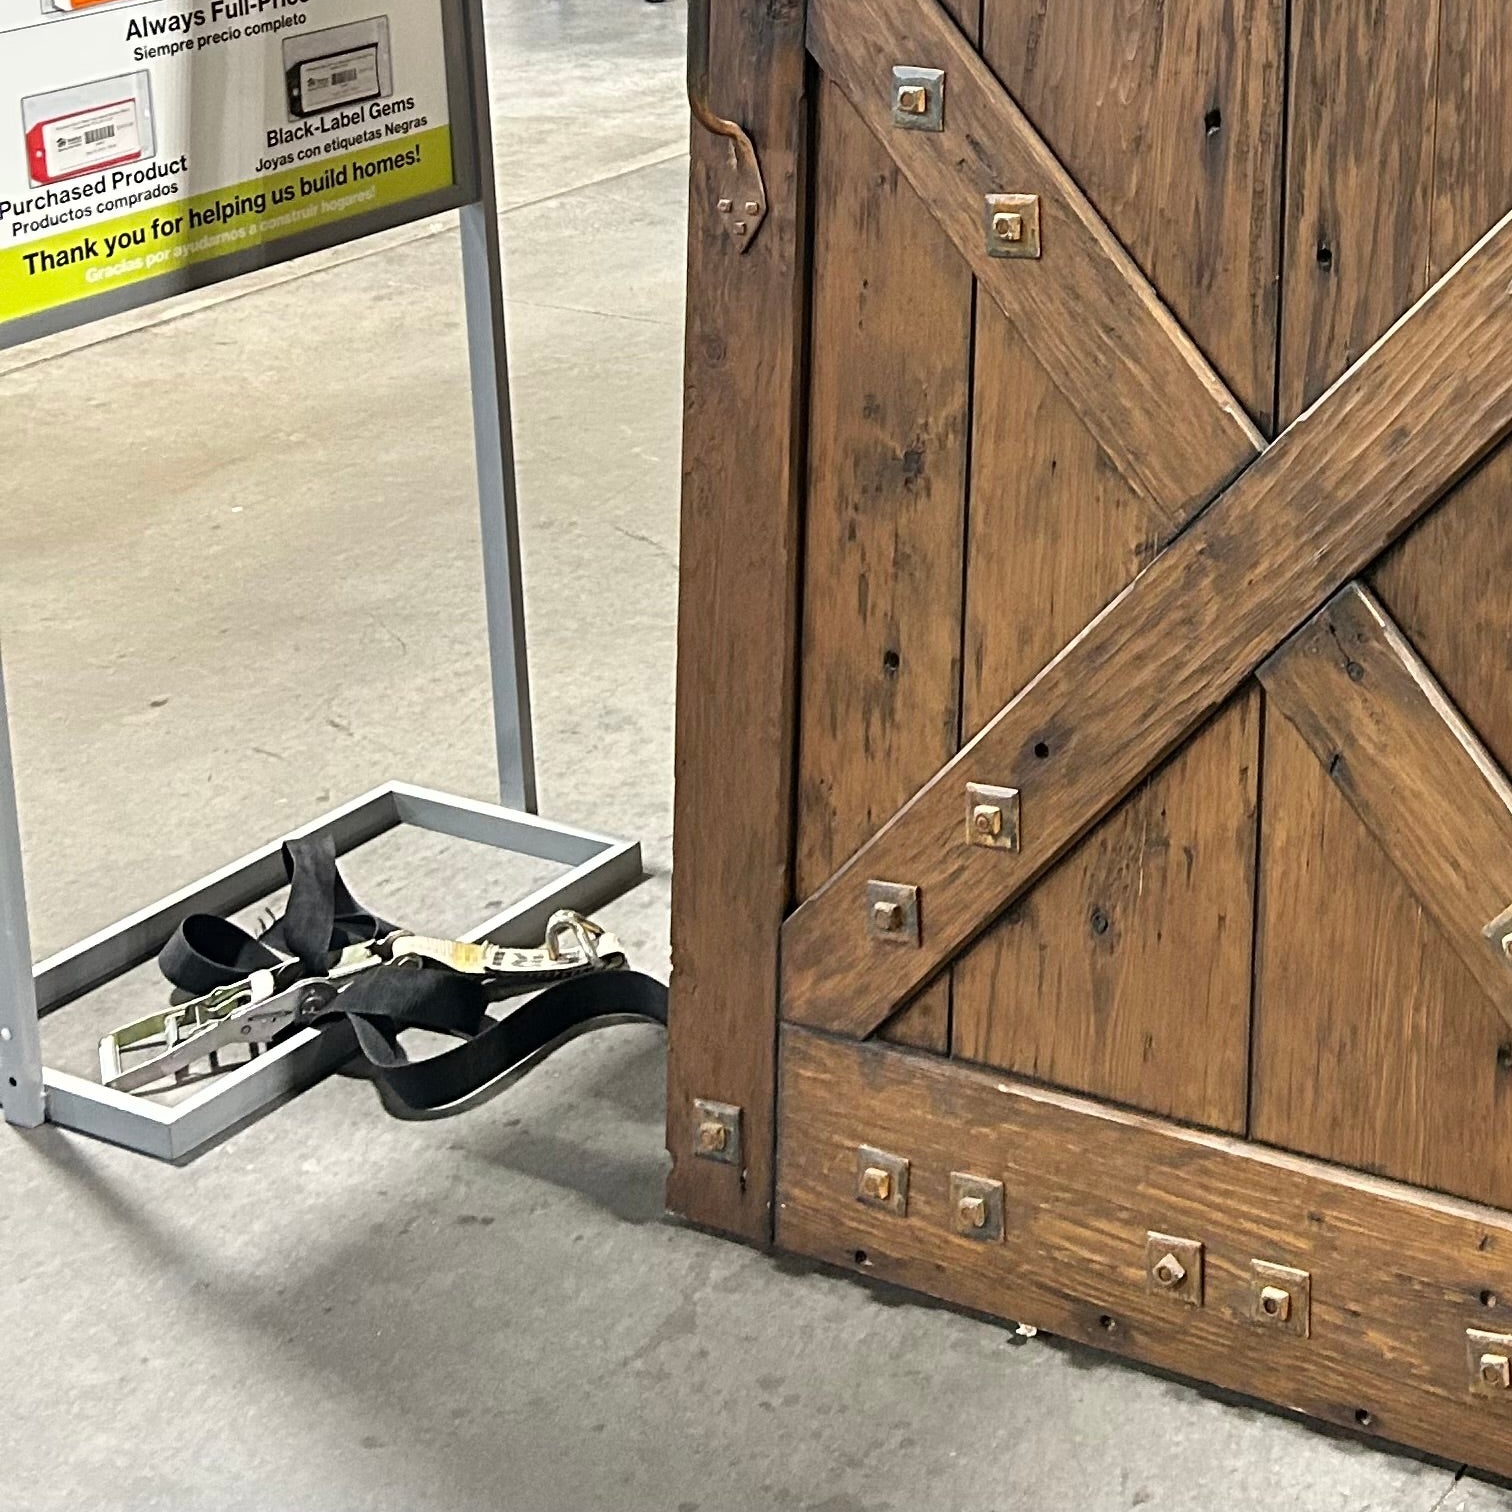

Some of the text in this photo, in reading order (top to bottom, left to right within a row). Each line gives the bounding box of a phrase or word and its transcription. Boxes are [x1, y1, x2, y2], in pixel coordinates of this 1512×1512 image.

[126, 9, 206, 41] Always
[133, 12, 307, 62] Siempre precio completo
[255, 115, 428, 173] Joyas con etiquetas Negras
[266, 96, 415, 148] Black-Label Gems
[0, 154, 189, 220] Purchased Product
[12, 181, 179, 237] Productos comprados
[22, 144, 421, 276] Thank you for helping us build homes!
[85, 256, 143, 284] Gracias
[145, 248, 170, 270] por
[260, 204, 320, 233] construir
